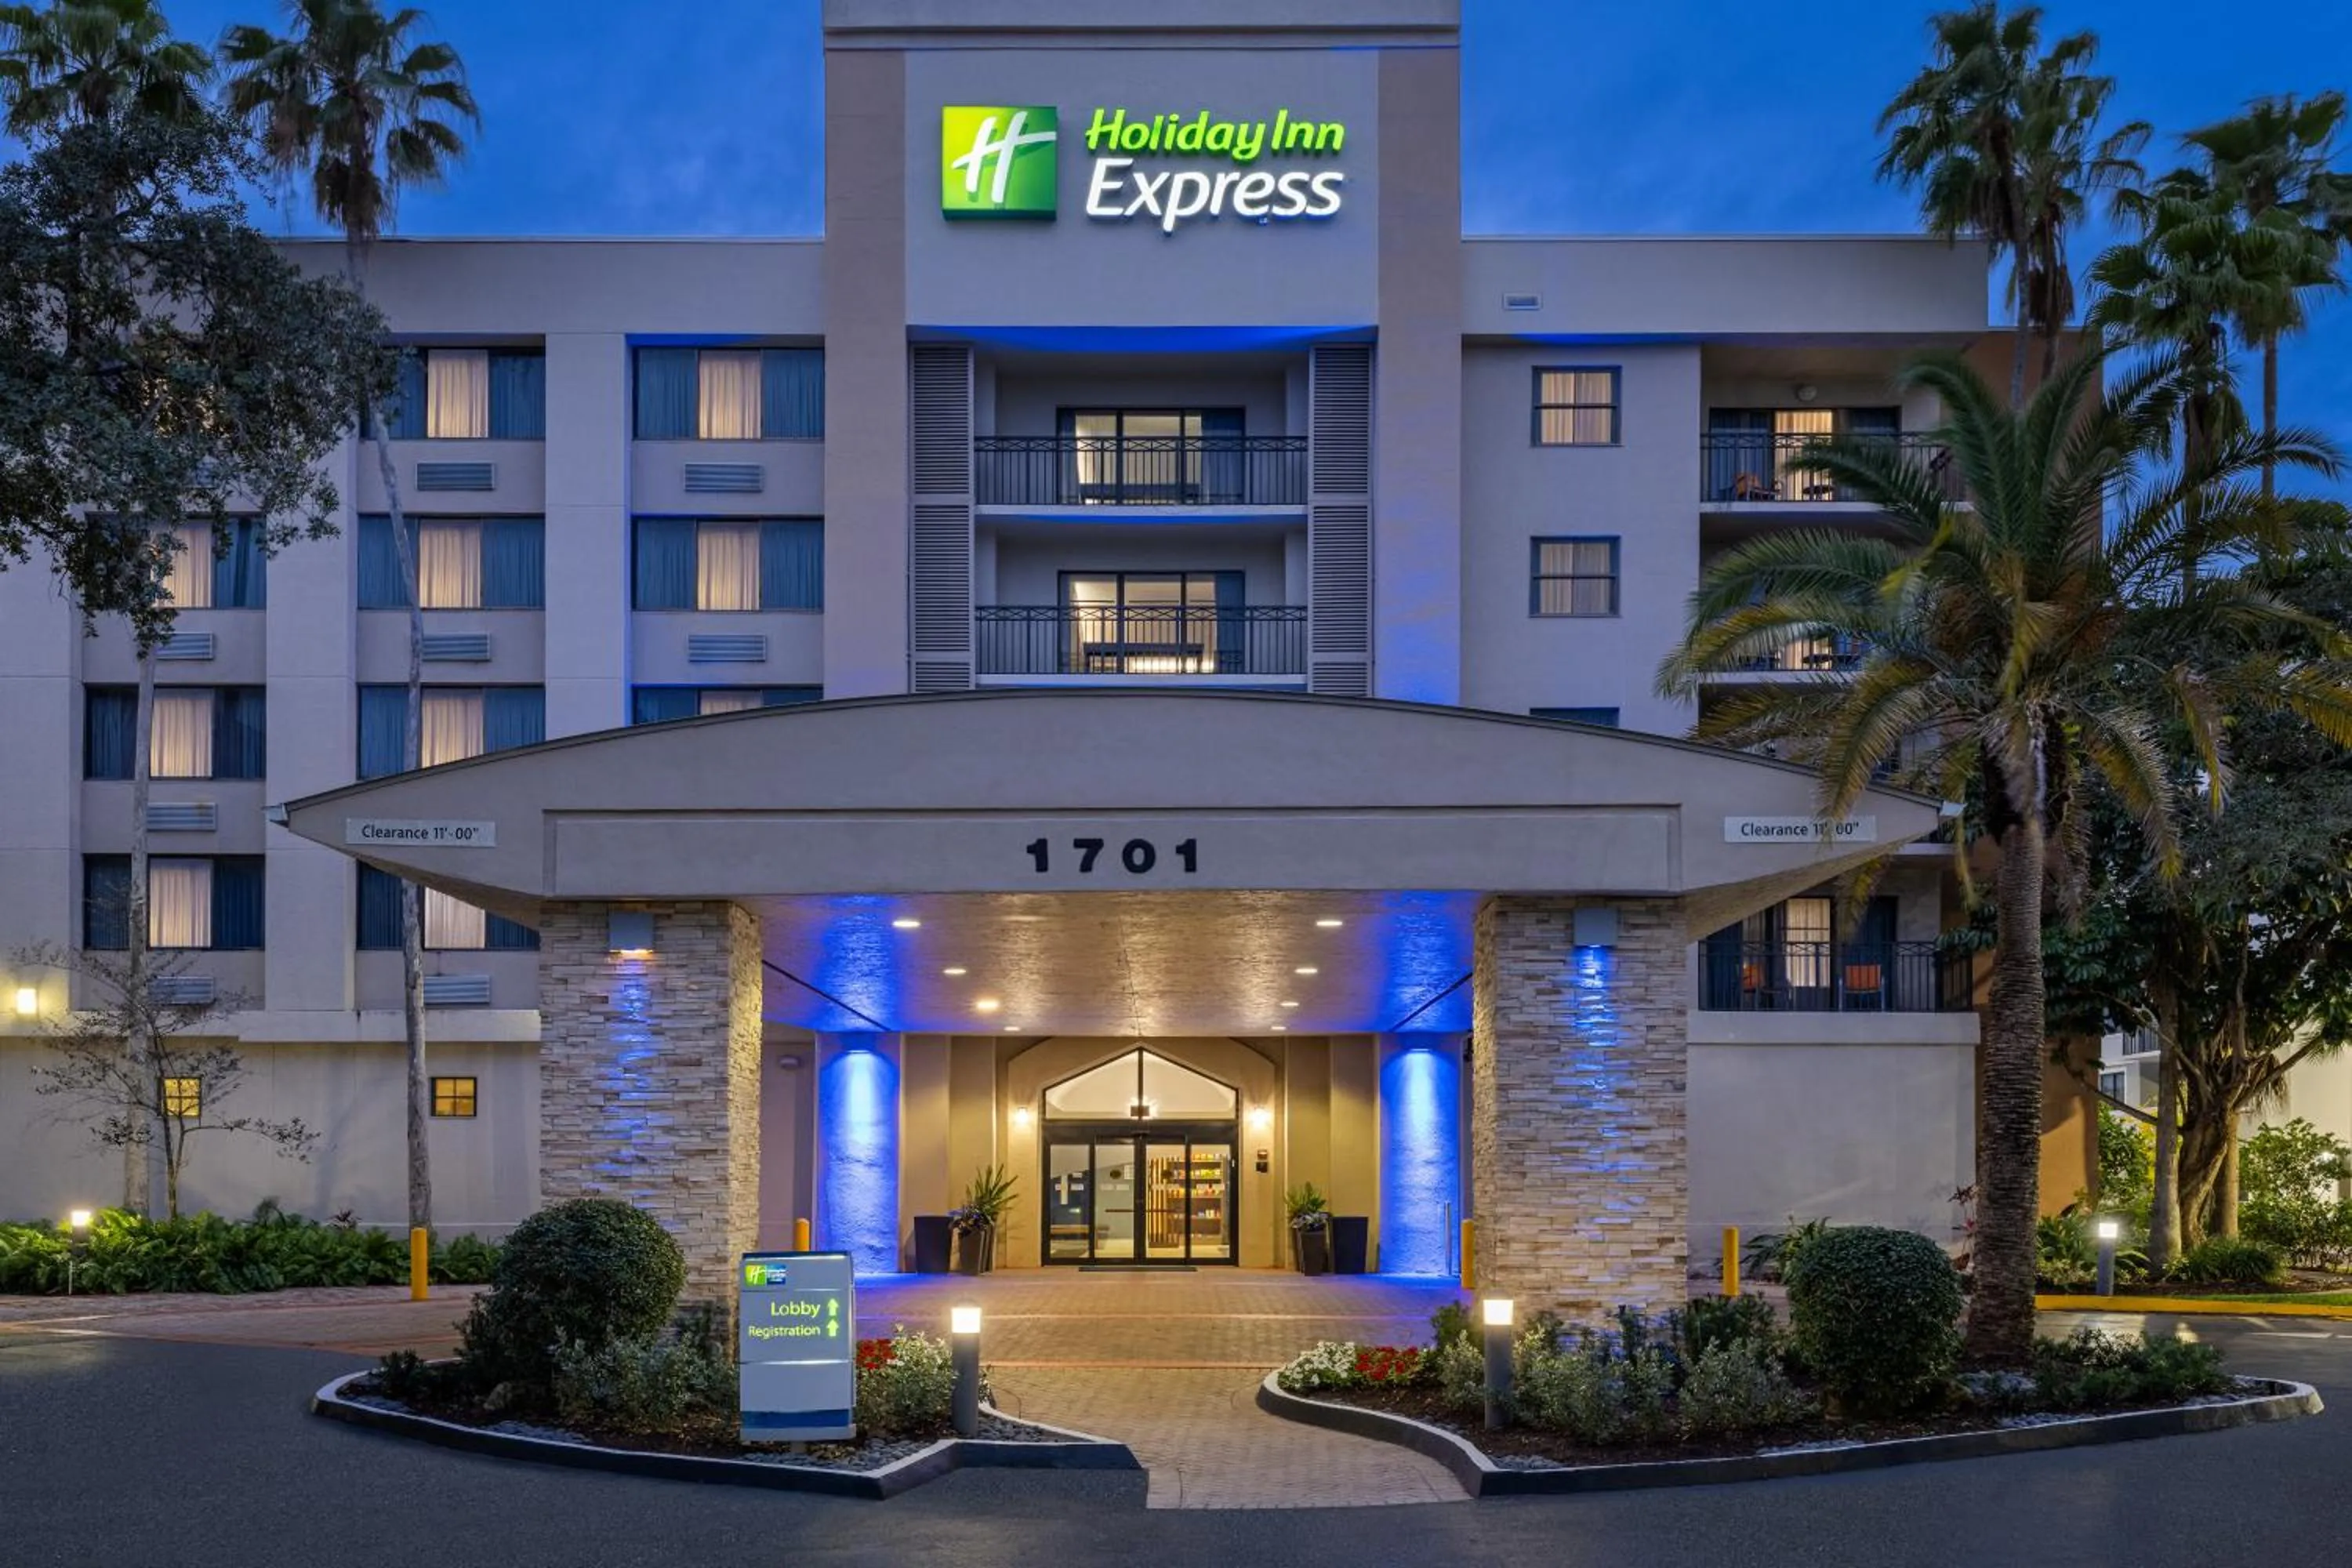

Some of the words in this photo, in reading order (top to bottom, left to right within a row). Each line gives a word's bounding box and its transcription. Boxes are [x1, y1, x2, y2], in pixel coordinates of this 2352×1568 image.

[1086, 109, 1264, 160] Holiday
[1271, 109, 1344, 151] Inn
[1085, 158, 1344, 234] Express
[361, 825, 428, 839] Clearance
[1741, 822, 1808, 836] Clearance
[770, 1301, 821, 1318] Lobby
[749, 1325, 821, 1339] Registration
